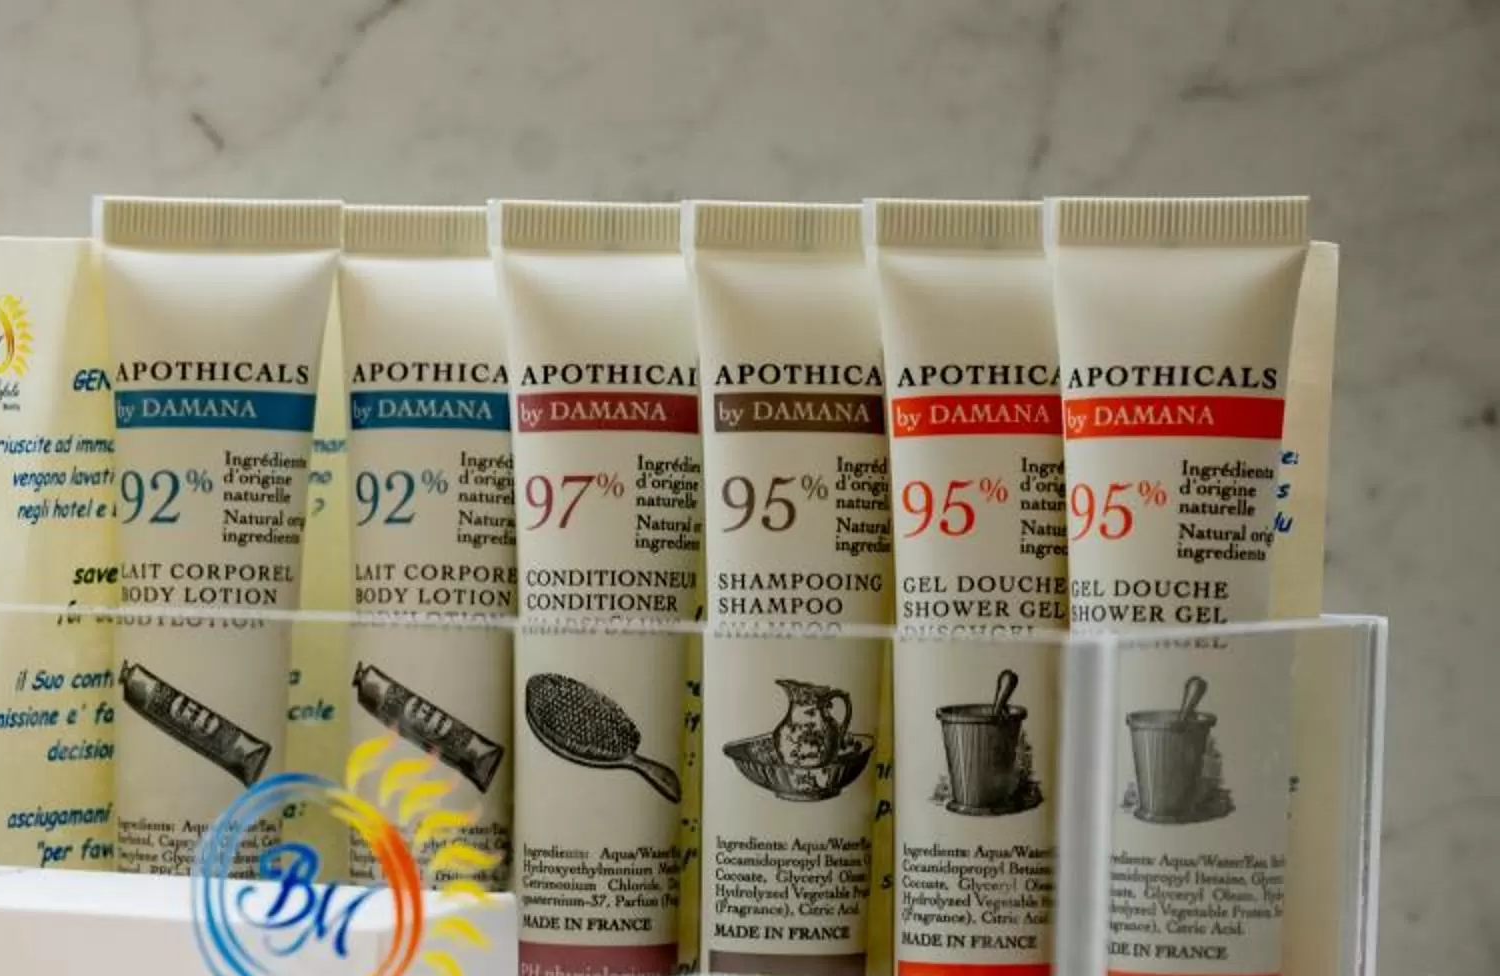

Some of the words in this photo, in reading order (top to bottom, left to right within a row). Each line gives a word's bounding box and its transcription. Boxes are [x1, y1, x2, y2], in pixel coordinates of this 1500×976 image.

[116, 361, 309, 385] APOTHICALS
[1068, 365, 1278, 390] APOTHICALS
[118, 401, 135, 422] by
[143, 398, 257, 418] DAMANA
[354, 403, 371, 423] by
[378, 399, 492, 420] DAMANA
[520, 404, 543, 428] by
[550, 401, 667, 422] DAMANA
[719, 402, 744, 425] by
[753, 401, 870, 423] DAMANA
[896, 406, 921, 431] by
[930, 404, 1050, 424] DAMANA
[1068, 408, 1087, 433] by
[1095, 406, 1215, 426] DAMANA
[55, 435, 73, 453] ad
[13, 471, 66, 492] vengono
[223, 470, 292, 488] d'origine
[1179, 478, 1257, 499] d'origine
[121, 468, 213, 524] 92%
[223, 489, 290, 504] naturelle
[356, 468, 449, 527] 92%
[524, 472, 625, 530] 97%
[722, 473, 829, 533] 95%
[18, 501, 49, 524] negli
[54, 499, 92, 518] hotel
[901, 477, 1009, 539] 95%
[1071, 479, 1167, 541] 95%
[1179, 499, 1255, 516] naturelle
[223, 510, 283, 526] Natural
[636, 514, 691, 531] Natural
[1178, 523, 1245, 542] Natural
[73, 567, 118, 584] save
[121, 562, 162, 579] LAIT
[170, 563, 294, 582] CORPOREL
[356, 563, 396, 581] LAIT
[718, 573, 883, 592] SHAMPOOING
[903, 576, 946, 594] GEL
[957, 576, 1066, 594] DOUCHE
[1072, 579, 1104, 597] GEL
[1114, 579, 1229, 599] DOUCHE
[121, 587, 175, 603] BODY
[185, 588, 278, 604] LOTION
[356, 588, 408, 604] BODY
[418, 589, 511, 605] LOTION
[527, 594, 678, 612] CONDITIONER
[718, 598, 843, 615] SHAMPOO
[903, 601, 1010, 619] SHOWER
[1020, 601, 1066, 619] GEL
[1072, 605, 1165, 623] SHOWER
[1175, 606, 1228, 624] GEL
[32, 670, 65, 690] Suo
[7, 802, 113, 831] asciugamani
[522, 915, 560, 930] MADE
[564, 917, 582, 930] IN
[587, 918, 653, 931] FRANCE
[714, 923, 760, 939] MADE
[764, 927, 784, 939] IN
[788, 926, 851, 940] FRANCE
[902, 931, 942, 947] MADE
[947, 935, 965, 948] IN
[971, 935, 1037, 949] FRANCE
[1133, 943, 1151, 958] IN
[1155, 945, 1228, 960] FRANCE
